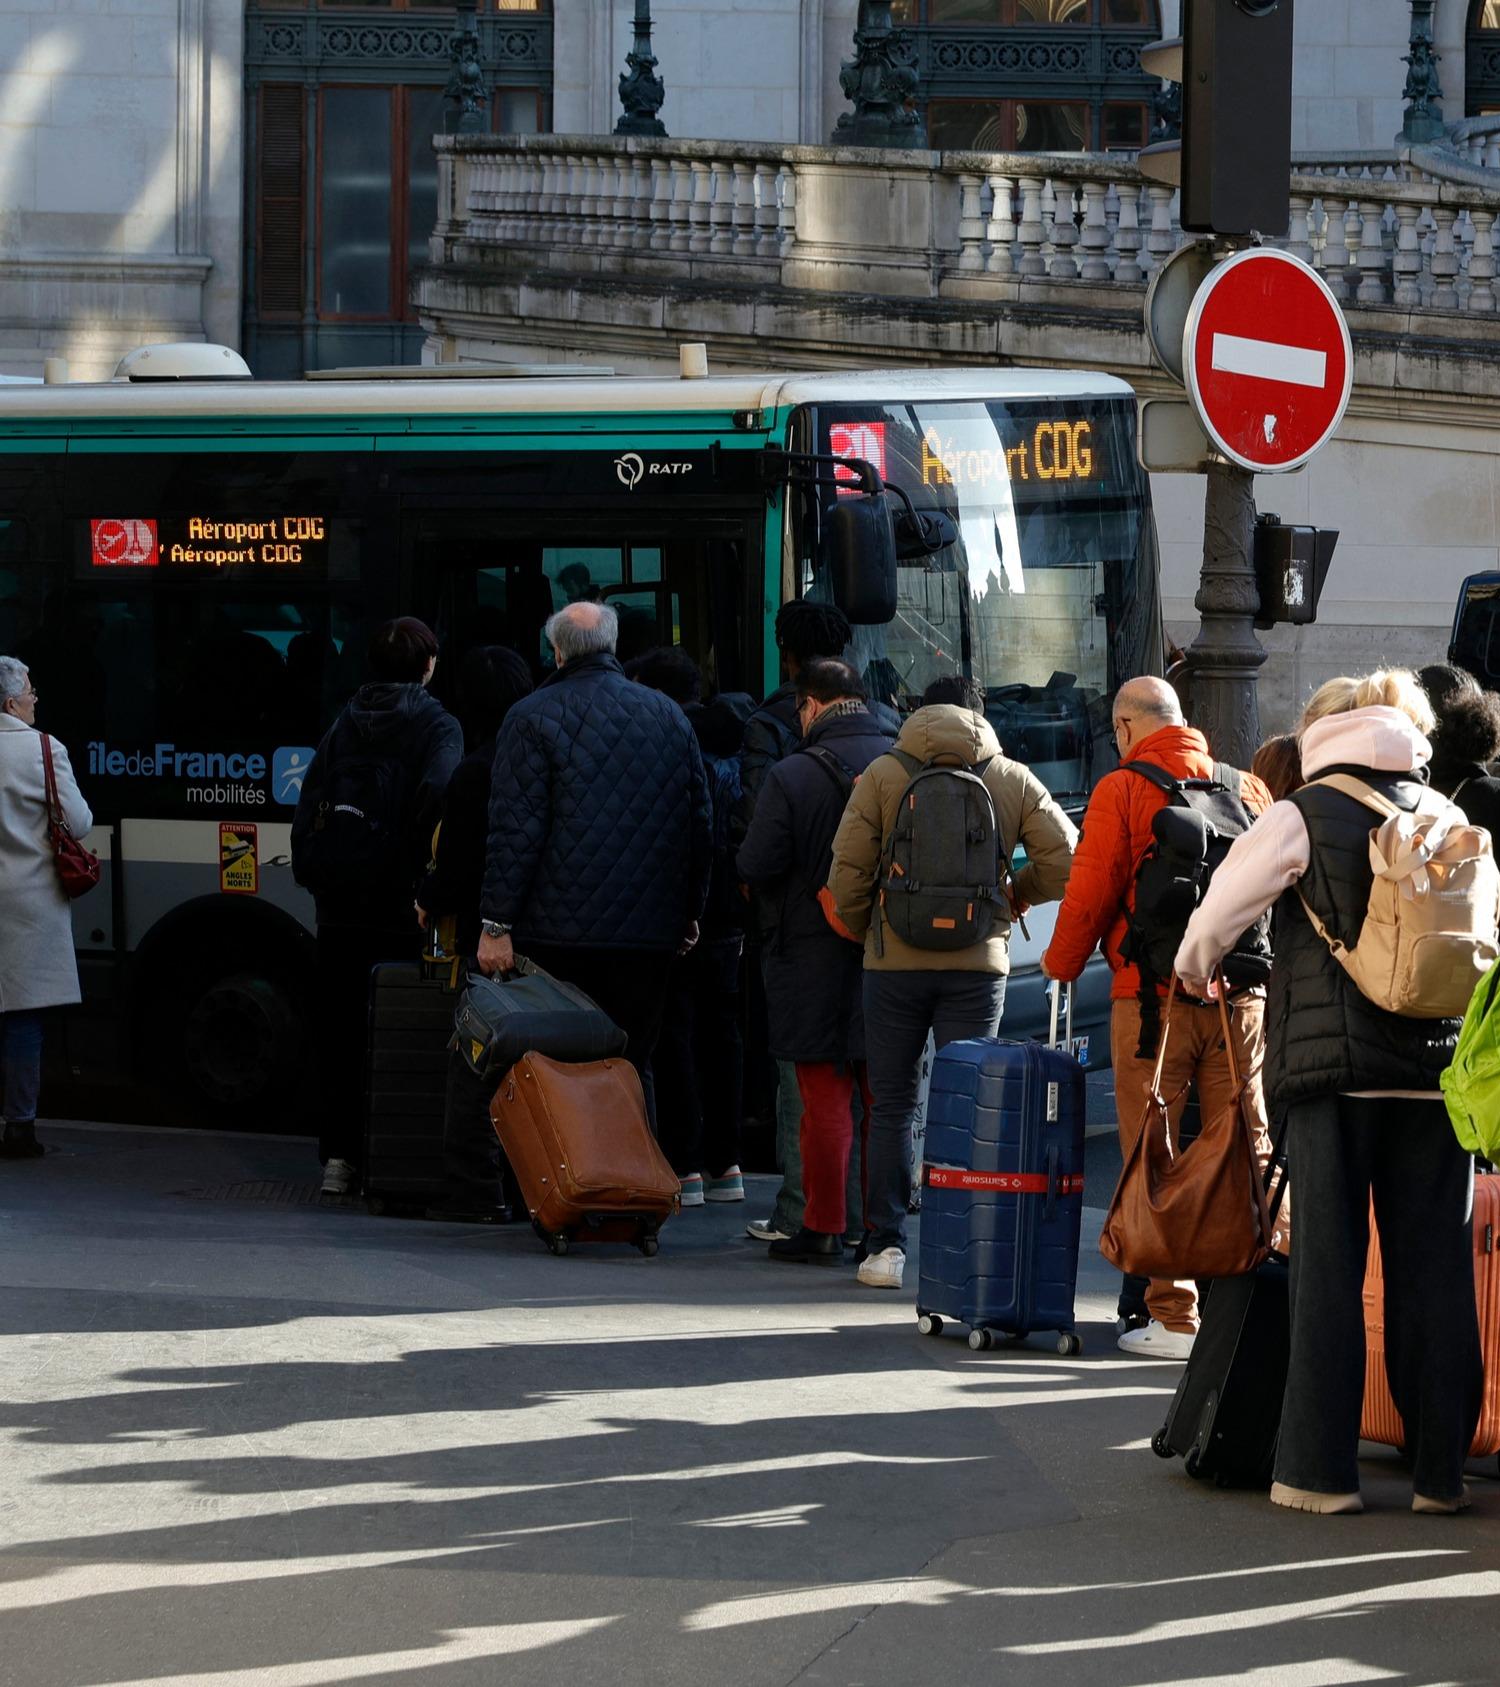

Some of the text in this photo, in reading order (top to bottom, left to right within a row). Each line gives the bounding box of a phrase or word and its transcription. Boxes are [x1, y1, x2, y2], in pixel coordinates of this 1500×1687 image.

[921, 420, 1092, 488] Aéroport CDG
[648, 463, 693, 474] RATP
[189, 517, 325, 543] Aéroport CDG
[171, 544, 302, 566] Aéroport CDG
[187, 783, 266, 805] mobilités
[221, 824, 255, 832] ATTENTION
[226, 871, 253, 880] ANGLES
